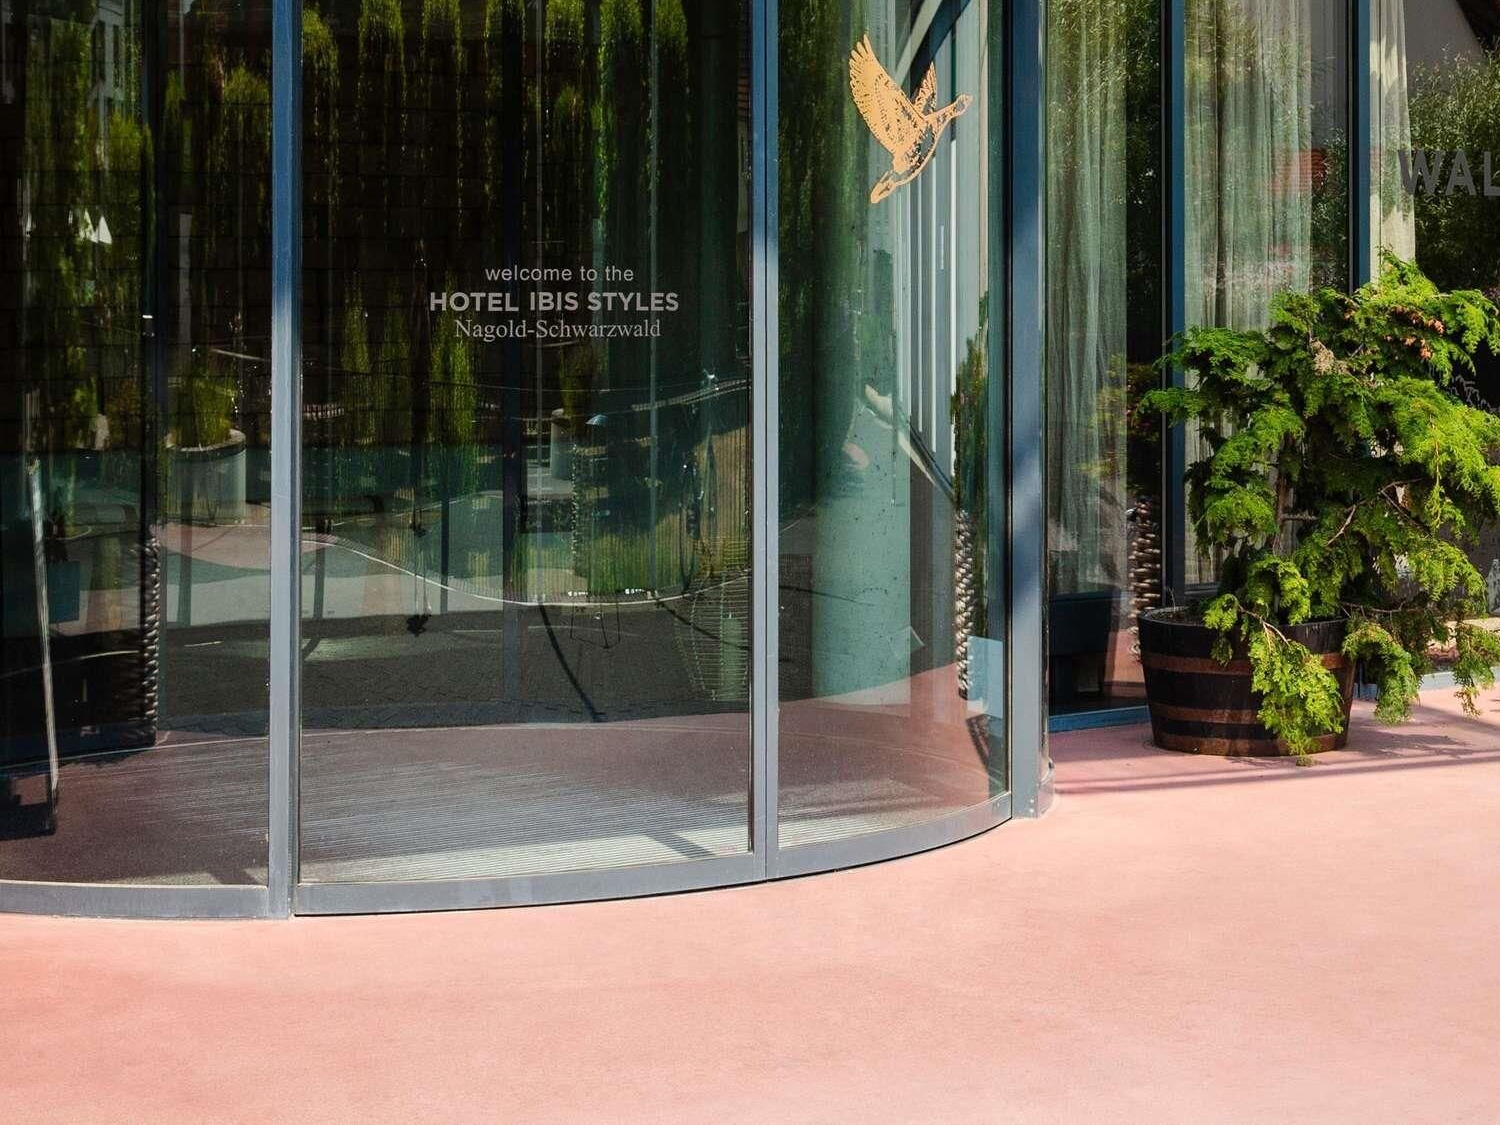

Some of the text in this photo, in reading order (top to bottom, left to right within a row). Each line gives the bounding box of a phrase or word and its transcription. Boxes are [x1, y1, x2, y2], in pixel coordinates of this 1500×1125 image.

[485, 265, 634, 282] welcome to the
[429, 291, 680, 313] HOTEL IBIS STYLES
[454, 319, 662, 343] Nagold-Schwarzwald
